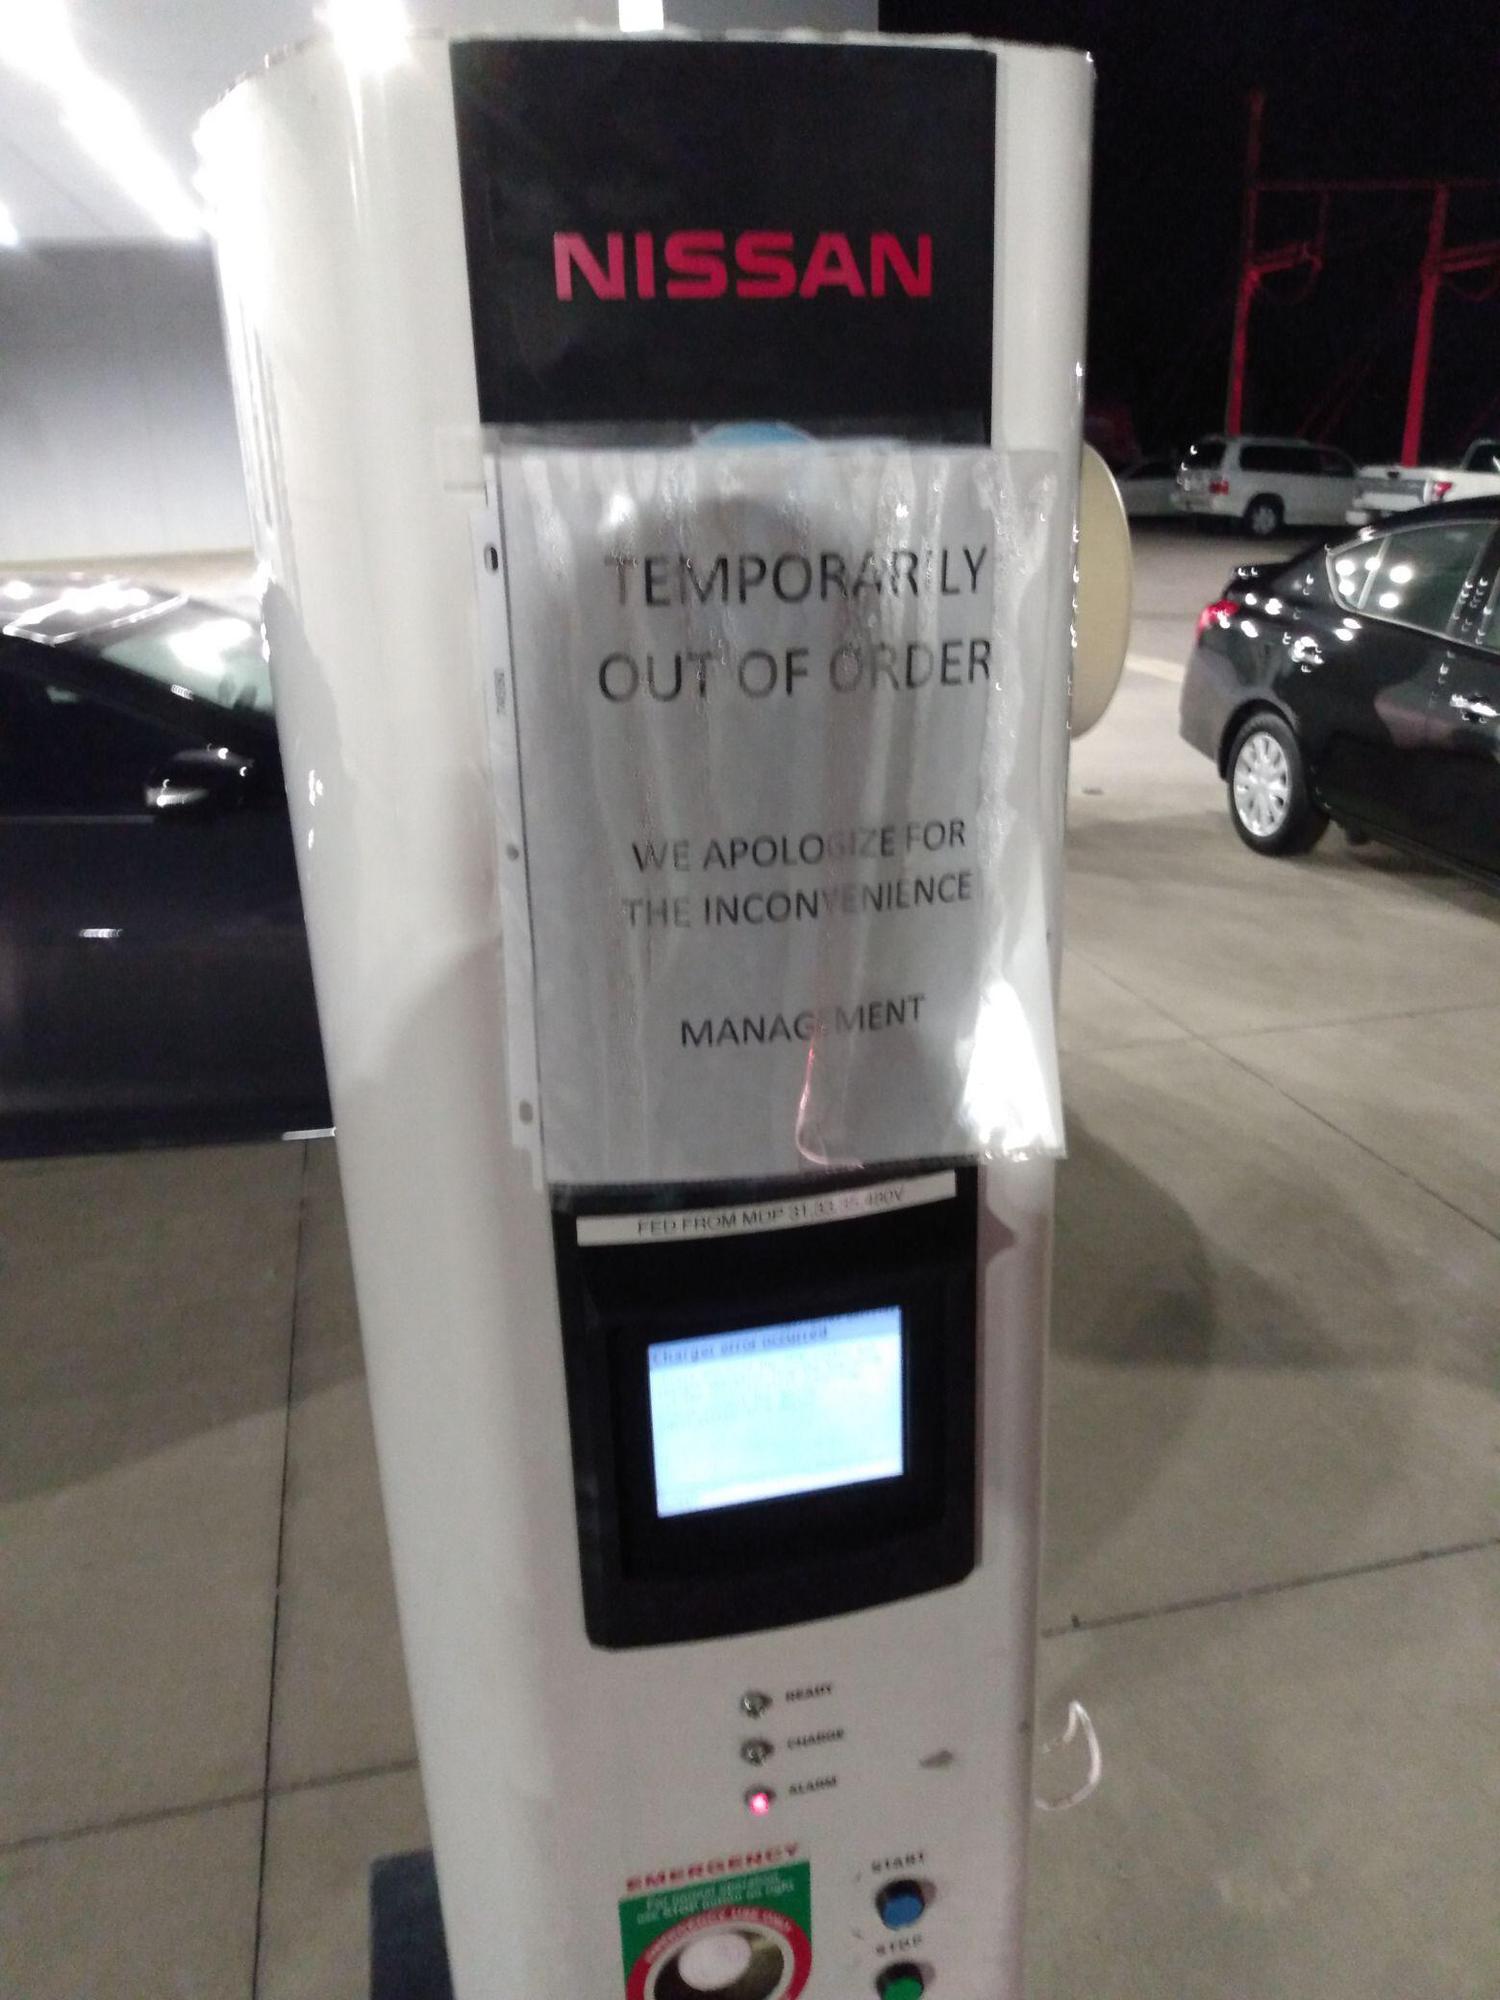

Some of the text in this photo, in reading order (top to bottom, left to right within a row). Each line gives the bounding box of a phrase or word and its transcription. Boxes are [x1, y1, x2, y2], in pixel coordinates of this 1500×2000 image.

[553, 230, 932, 300] NISSAN
[599, 638, 992, 702] OUT OF ORDER
[631, 818, 966, 873] WE APOLOGIZE FOR
[627, 870, 973, 929] THE INCONVENIENCE
